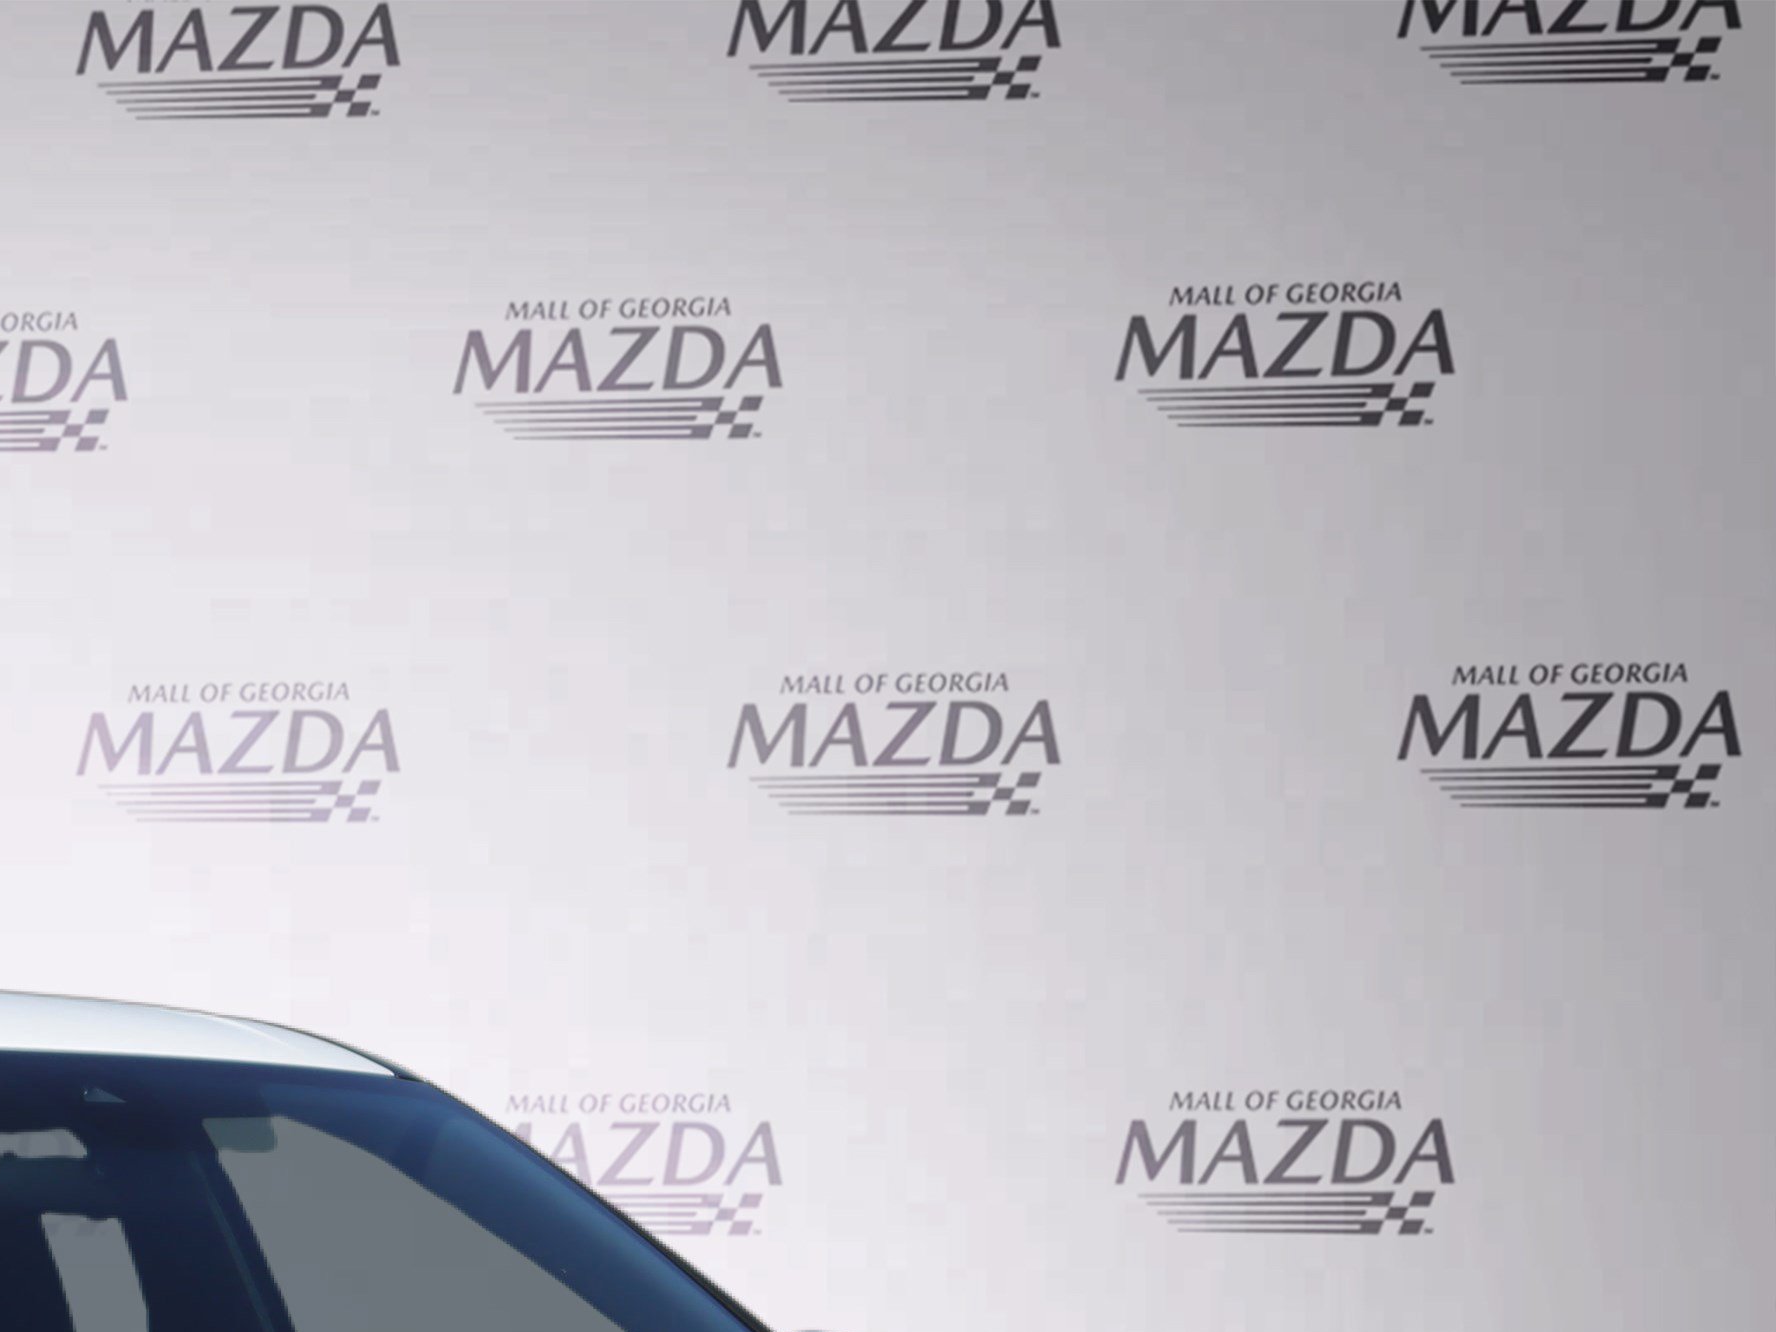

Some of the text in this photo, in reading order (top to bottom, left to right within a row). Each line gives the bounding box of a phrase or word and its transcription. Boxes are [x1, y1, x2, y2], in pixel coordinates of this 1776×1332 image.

[76, 2, 400, 75] MAZDA
[727, 0, 1061, 57] MAZDA
[506, 297, 731, 320] MALL OF GEORGIA
[1169, 281, 1402, 306] MALL OF GEORGIA
[453, 323, 783, 394] MAZDA
[1115, 308, 1455, 381] MAZDA
[128, 681, 349, 703] MALL OF GEORGIA
[780, 672, 1009, 694] MALL OF GEORGIA
[1452, 662, 1688, 685] MALL OF GEORGIA
[76, 708, 400, 776] MAZDA
[727, 699, 1061, 768] MAZDA
[1397, 690, 1742, 760] MAZDA
[505, 1093, 731, 1114] MALL OF GEORGIA
[1170, 1090, 1401, 1111] MALL OF GEORGIA
[514, 1120, 783, 1187] AZDA
[1115, 1118, 1455, 1185] MAZDA
